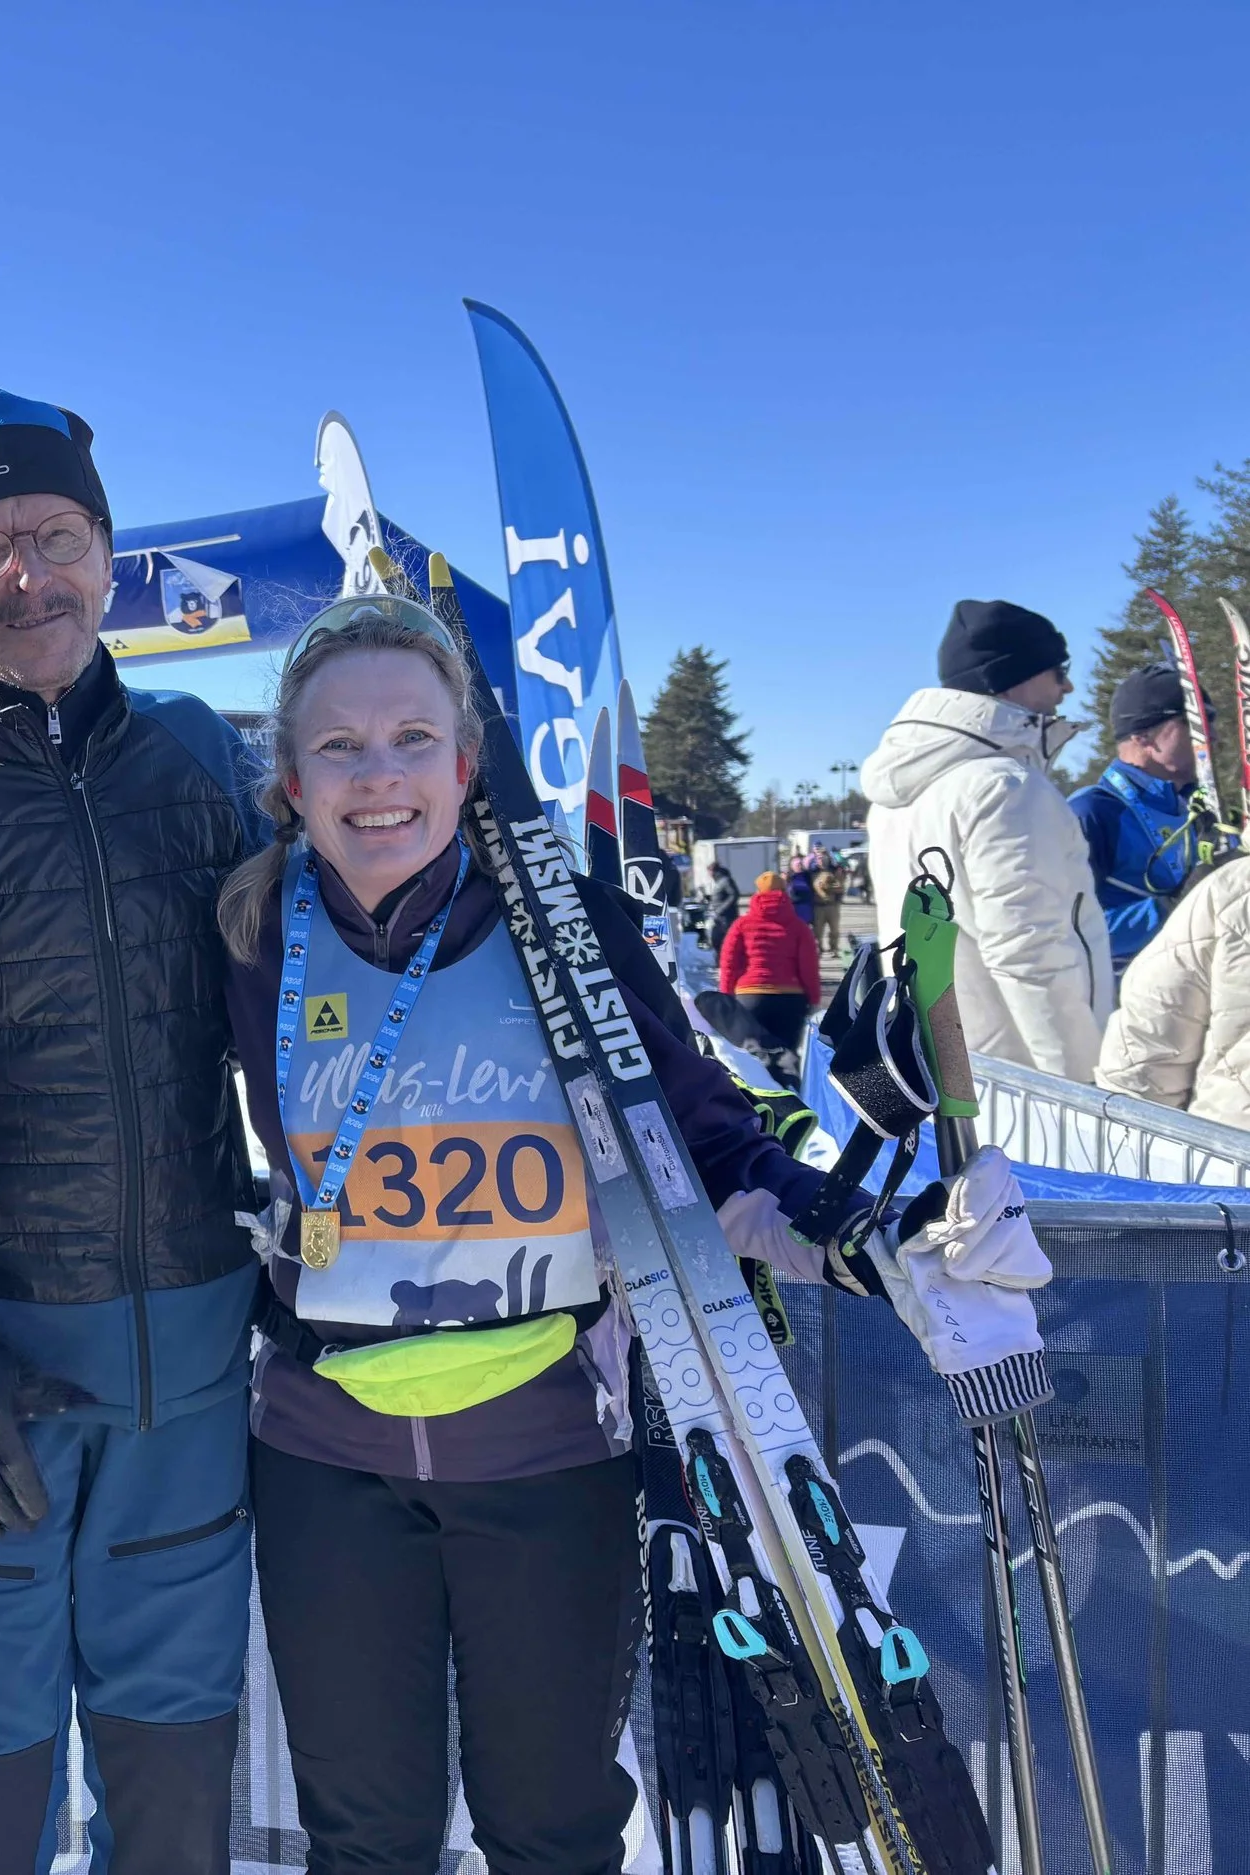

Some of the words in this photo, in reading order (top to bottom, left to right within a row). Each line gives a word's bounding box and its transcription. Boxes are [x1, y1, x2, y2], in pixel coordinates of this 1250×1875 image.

[311, 1133, 565, 1228] 1320
[625, 1269, 669, 1292] CLASSIC
[702, 1293, 753, 1314] CLASSIC
[699, 1474, 713, 1499] MOVE
[819, 1497, 835, 1524] MOVE
[801, 1529, 828, 1571] TUNE
